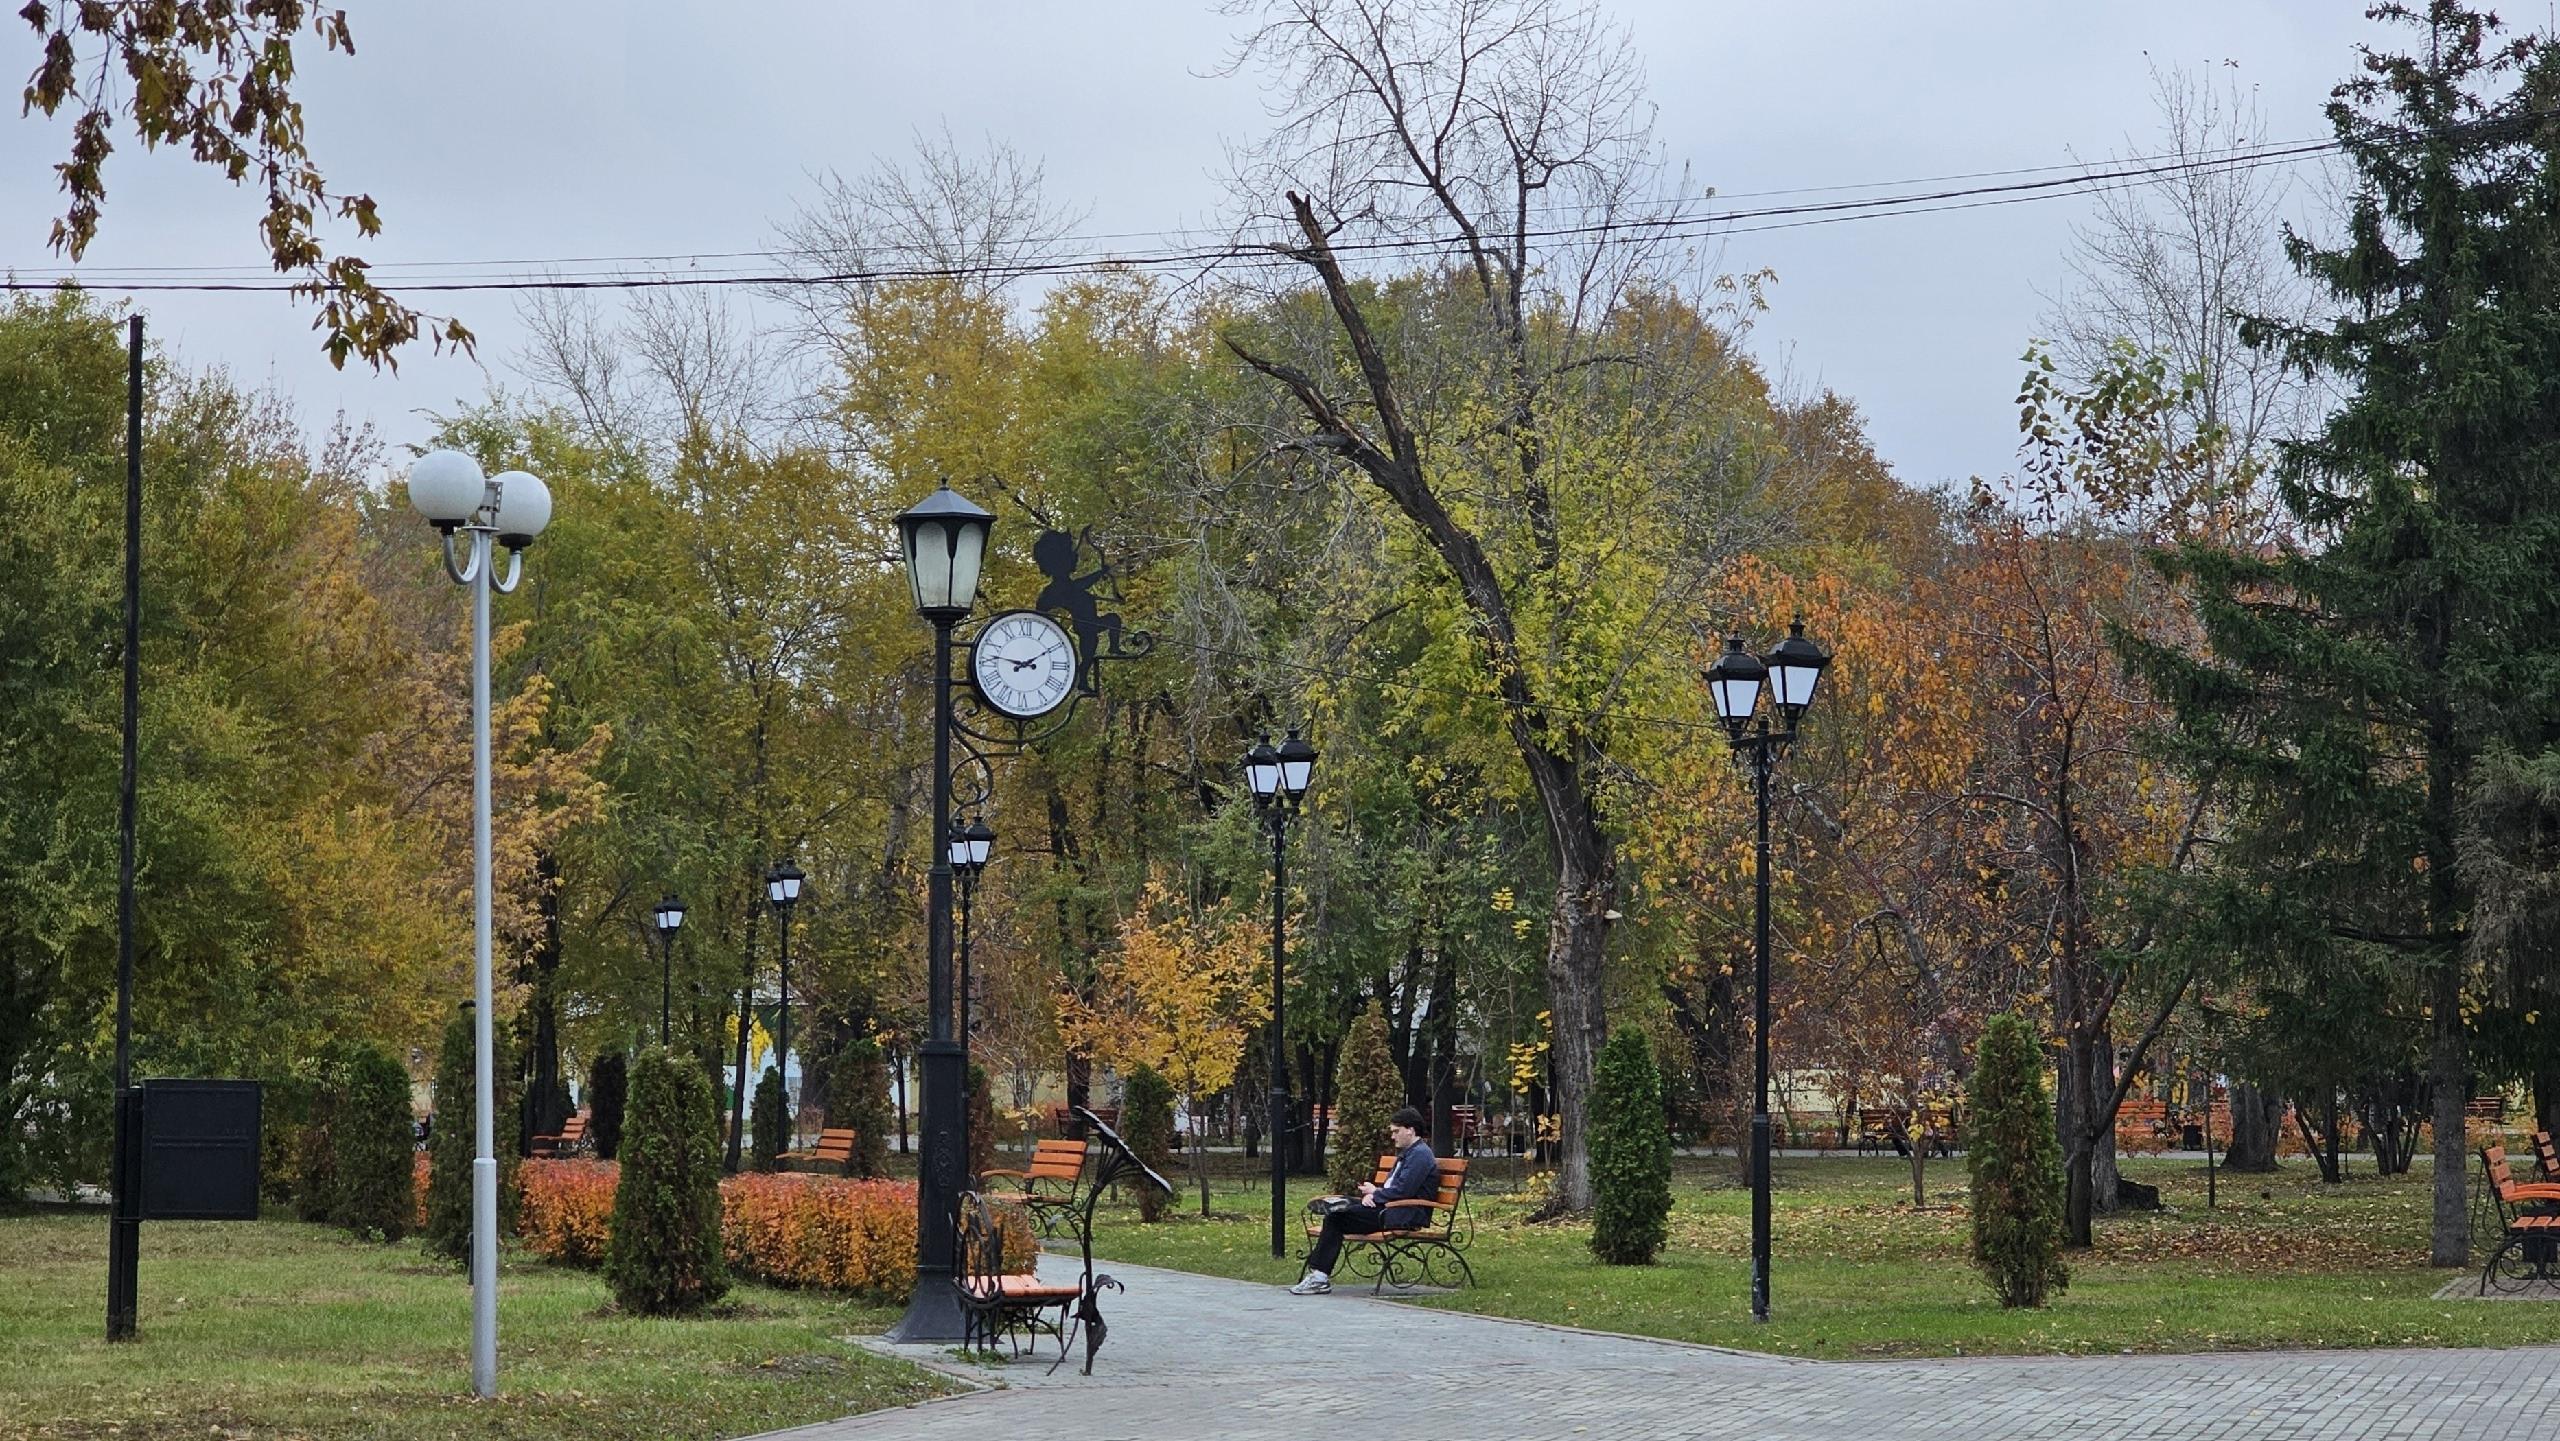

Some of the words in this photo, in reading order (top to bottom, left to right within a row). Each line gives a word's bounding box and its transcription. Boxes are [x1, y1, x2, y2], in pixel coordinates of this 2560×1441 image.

[1001, 624, 1015, 641] XI
[1019, 621, 1032, 636] XII
[1038, 626, 1048, 640] I
[1048, 642, 1063, 653] II
[1052, 661, 1067, 671] III
[985, 670, 1000, 690] VIII
[997, 685, 1012, 703] VII
[1018, 692, 1028, 708] VI
[1038, 690, 1048, 704] V
